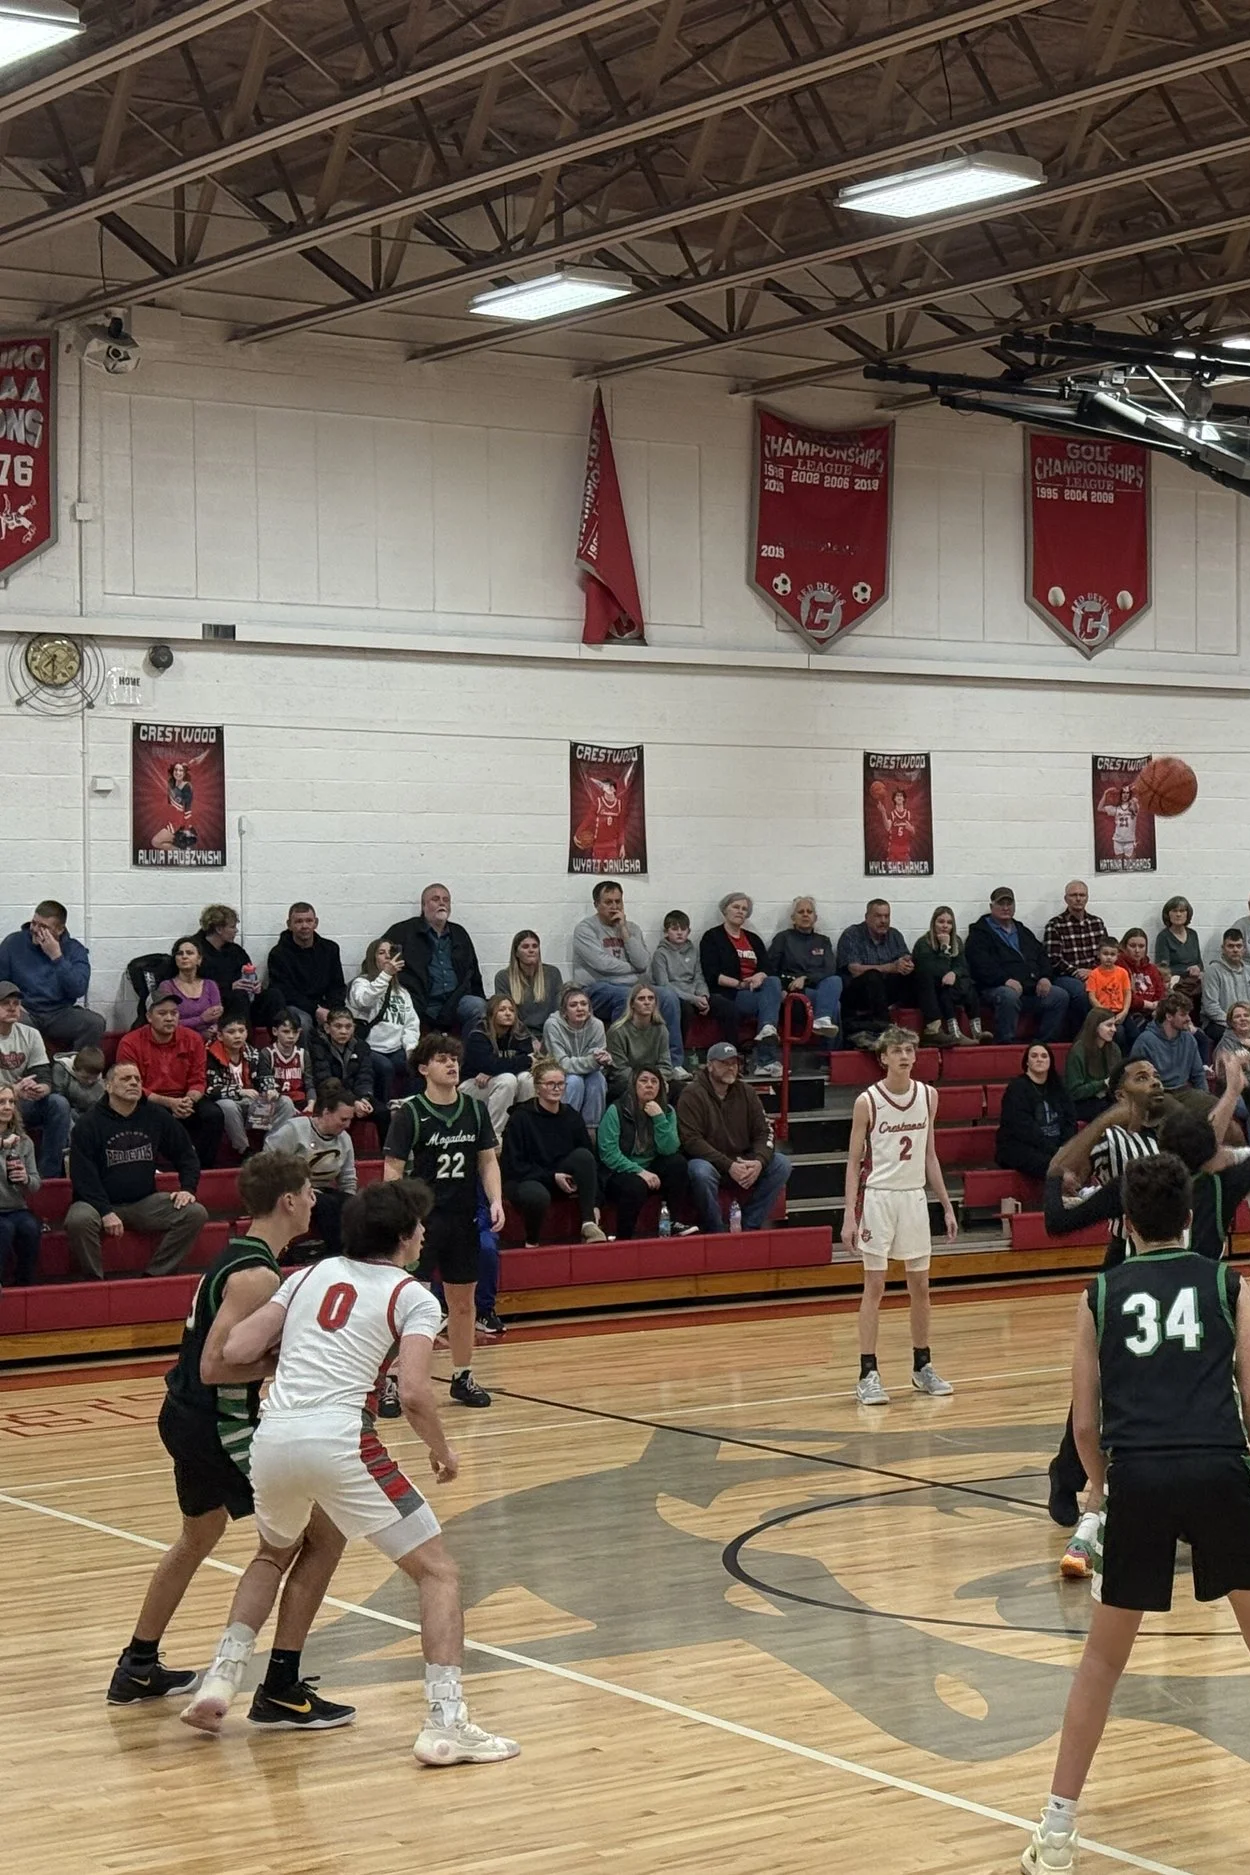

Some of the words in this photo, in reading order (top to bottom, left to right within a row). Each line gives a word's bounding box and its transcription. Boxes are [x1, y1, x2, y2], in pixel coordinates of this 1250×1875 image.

[1066, 442, 1113, 462] GOLF
[796, 458, 853, 476] LEAGUE
[1034, 456, 1144, 489] CHAMPIONSHIPS
[791, 470, 820, 485] 2002
[1065, 477, 1114, 491] LEAGUE
[119, 676, 141, 687] HOME
[139, 725, 217, 743] CRESTWOOD
[576, 745, 638, 763] CRESTWOOD
[869, 755, 926, 770] CRESTWOOD
[879, 1116, 927, 1134] Crestwood
[425, 1129, 476, 1149] Mogadore
[899, 1135, 912, 1161] 2
[436, 1152, 465, 1179] 22
[317, 1282, 358, 1332] 0
[1122, 1286, 1203, 1357] 34
